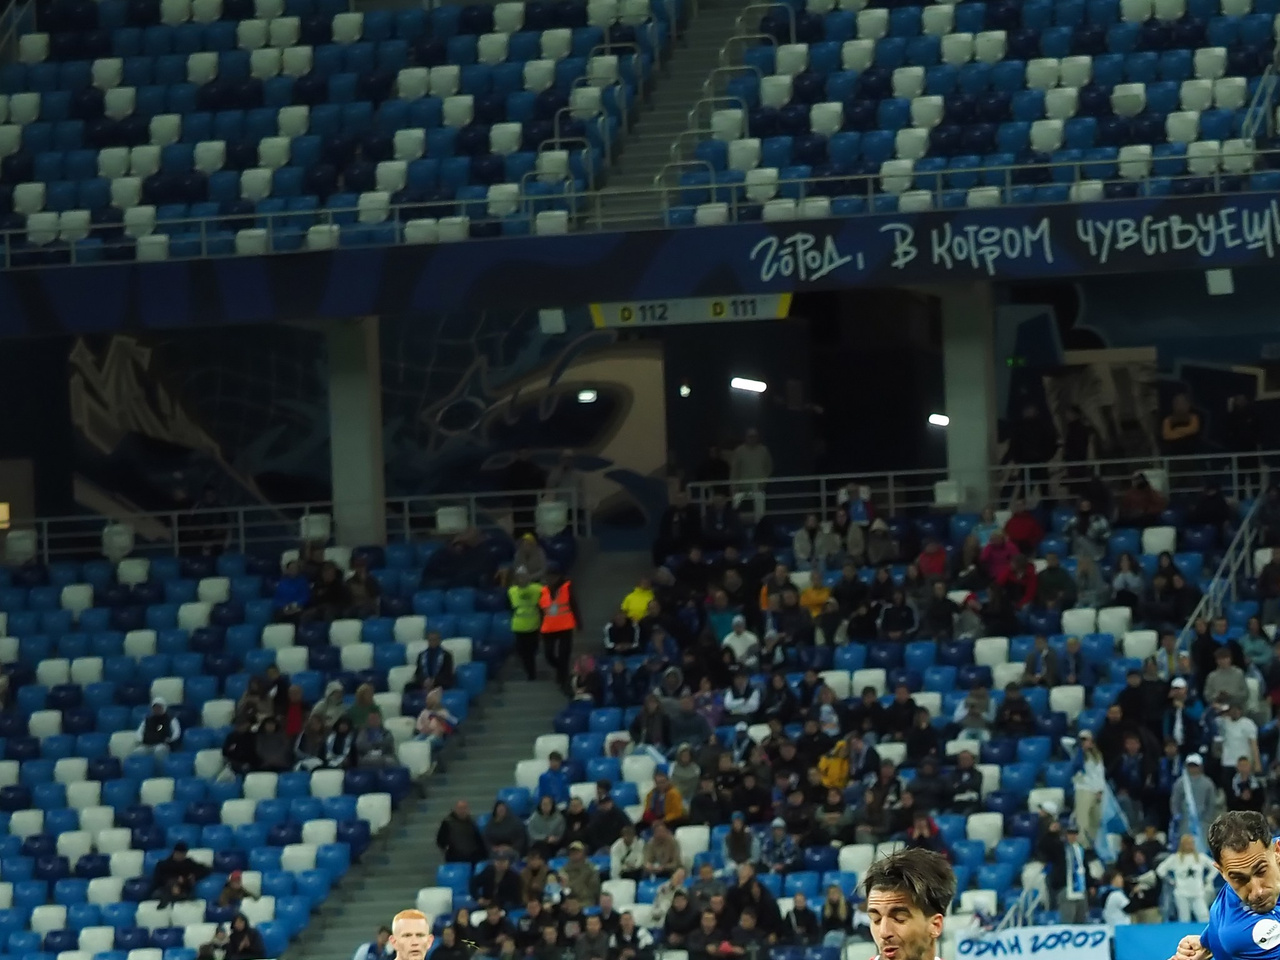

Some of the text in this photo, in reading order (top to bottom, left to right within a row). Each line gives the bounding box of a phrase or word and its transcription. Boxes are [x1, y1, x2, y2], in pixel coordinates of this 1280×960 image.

[879, 222, 918, 269] В
[620, 300, 757, 322] D 112 D 111
